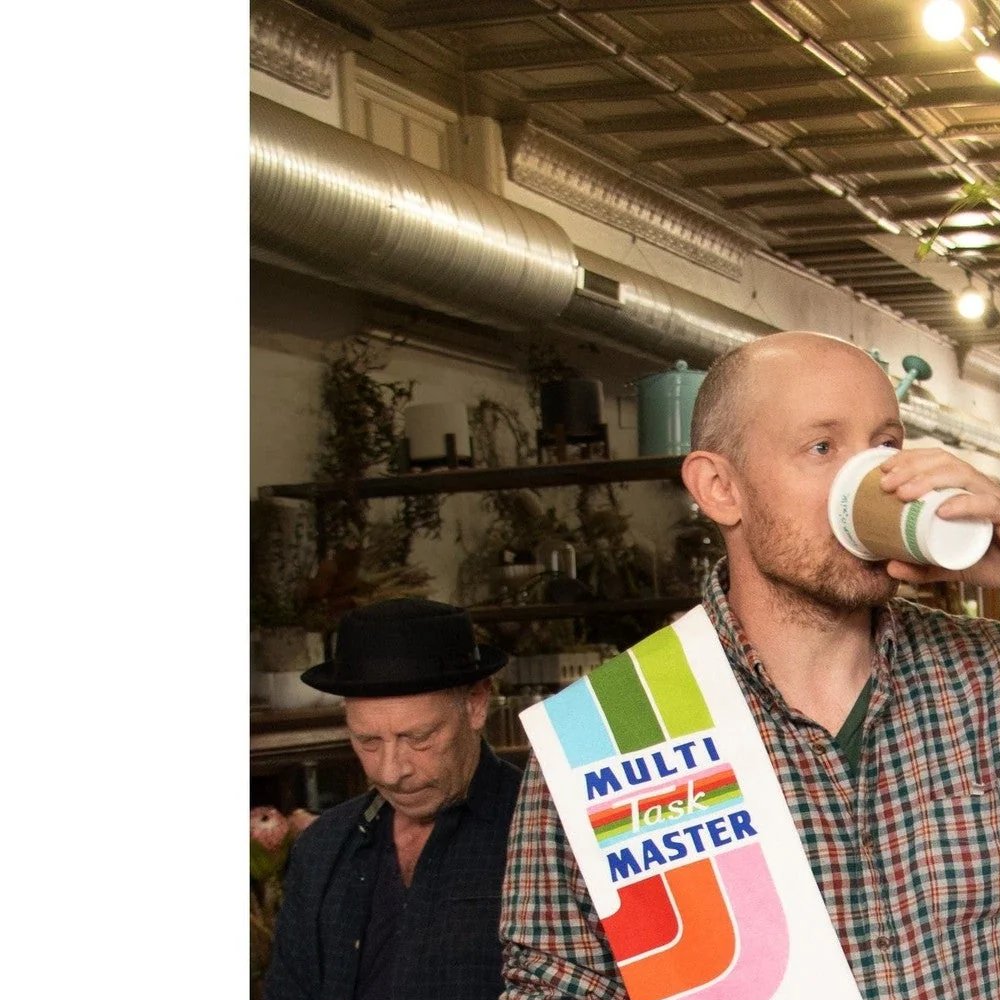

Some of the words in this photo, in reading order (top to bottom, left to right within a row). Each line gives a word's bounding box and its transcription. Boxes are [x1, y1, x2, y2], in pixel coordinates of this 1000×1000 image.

[584, 736, 720, 800] MULTI
[611, 780, 709, 833] Task
[606, 809, 758, 883] MASTER
